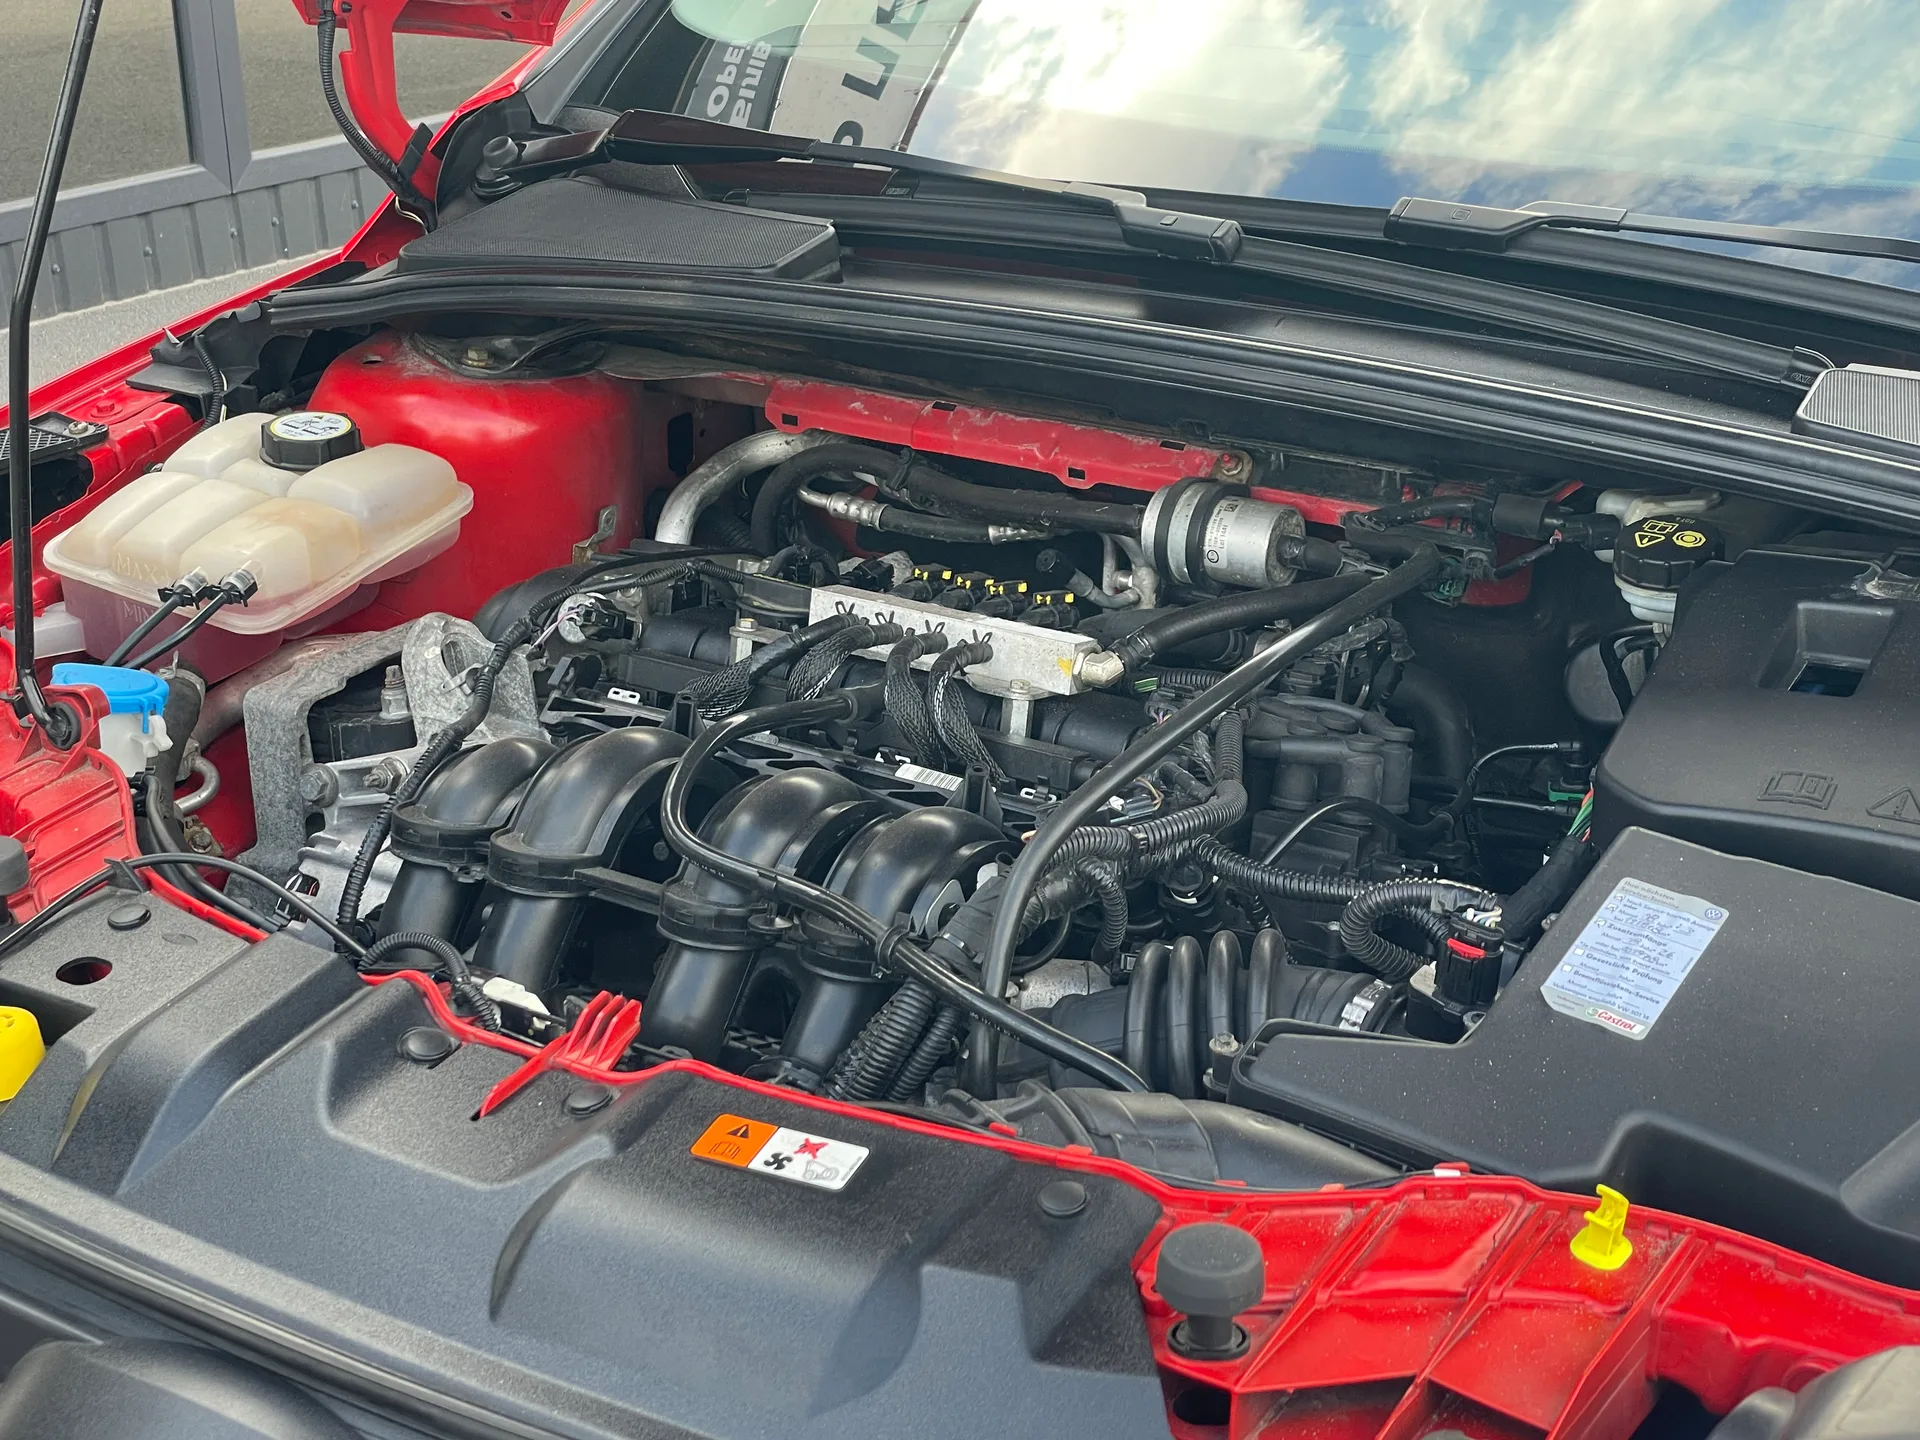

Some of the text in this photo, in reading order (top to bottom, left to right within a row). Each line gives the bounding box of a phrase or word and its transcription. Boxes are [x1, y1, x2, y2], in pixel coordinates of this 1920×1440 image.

[117, 552, 158, 584] MAX
[1586, 952, 1631, 972] Gesetzliche
[1631, 968, 1663, 985] Prüfung
[1597, 1010, 1637, 1032] Castrol
